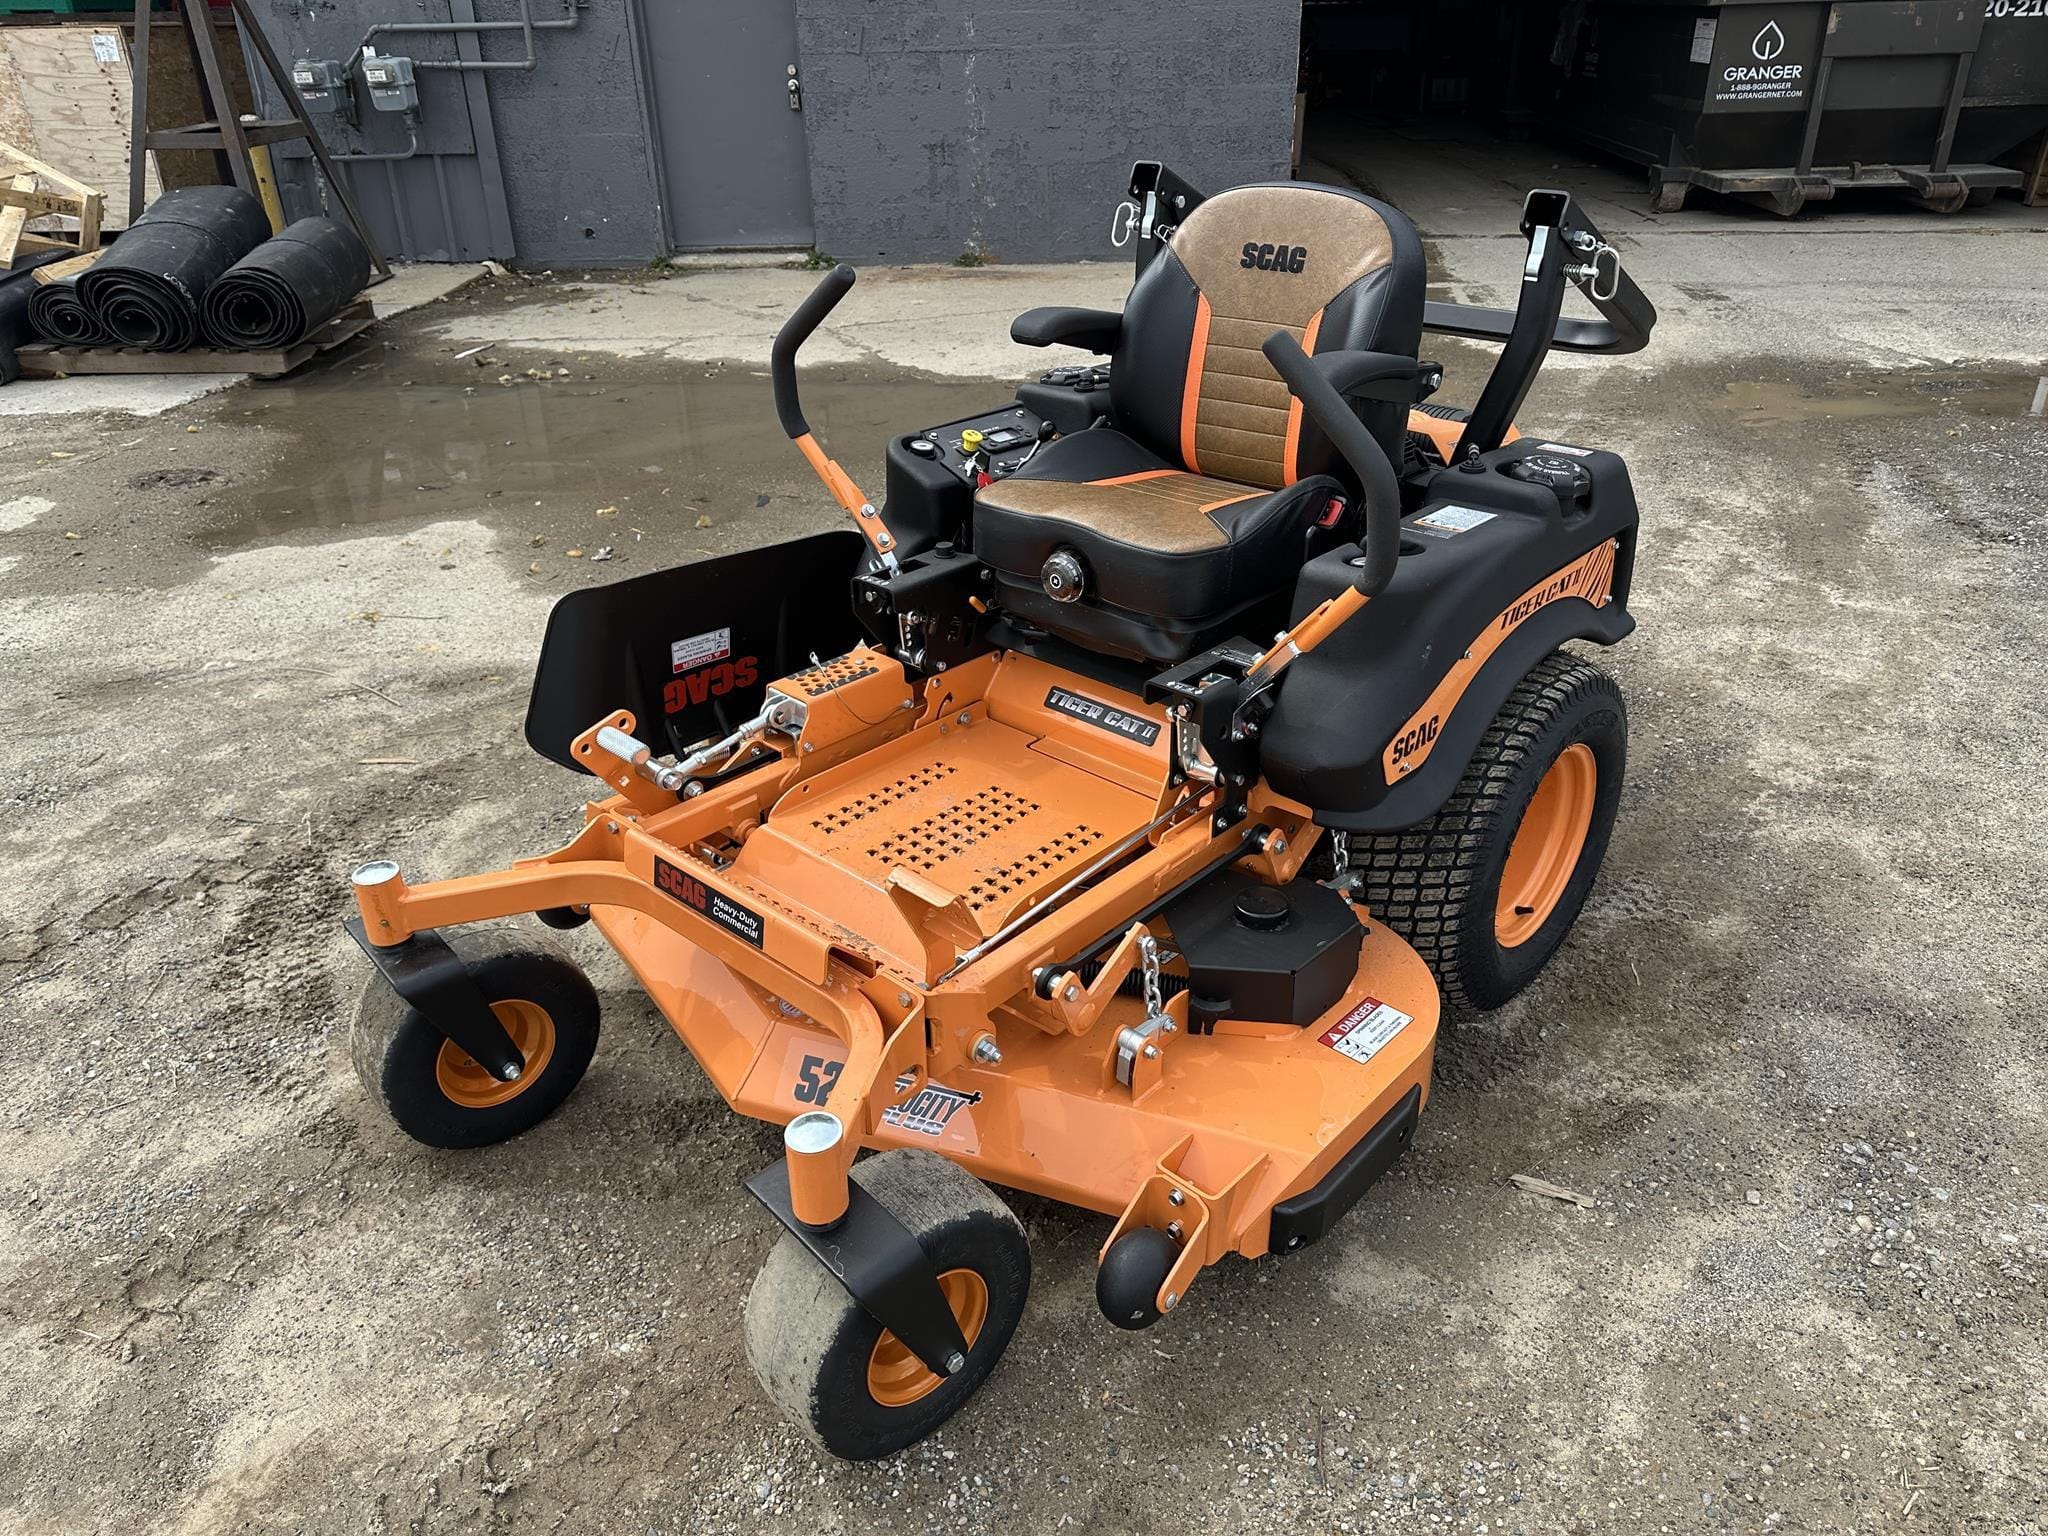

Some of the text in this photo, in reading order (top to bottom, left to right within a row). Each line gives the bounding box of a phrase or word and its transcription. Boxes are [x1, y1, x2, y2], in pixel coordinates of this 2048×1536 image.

[1984, 0, 2048, 17] 20-21
[1723, 65, 1803, 81] GRANGER
[1730, 82, 1792, 91] 1-888-9GRANGER
[1715, 90, 1803, 100] WWW.GRANGERNET.COM
[1240, 242, 1307, 274] SCAG
[1500, 589, 1547, 631] TIGER
[1545, 571, 1575, 602] CAT
[682, 655, 713, 669] DANGER
[663, 656, 758, 714] SCAG
[1049, 690, 1157, 739] TIGER CAT II
[1391, 714, 1439, 765] SCAG
[658, 862, 707, 910] SCAG
[712, 906, 759, 939] Commercial
[713, 896, 758, 929] Heavy-Duty
[1337, 1002, 1377, 1033] DANGER
[793, 1054, 845, 1106] 52
